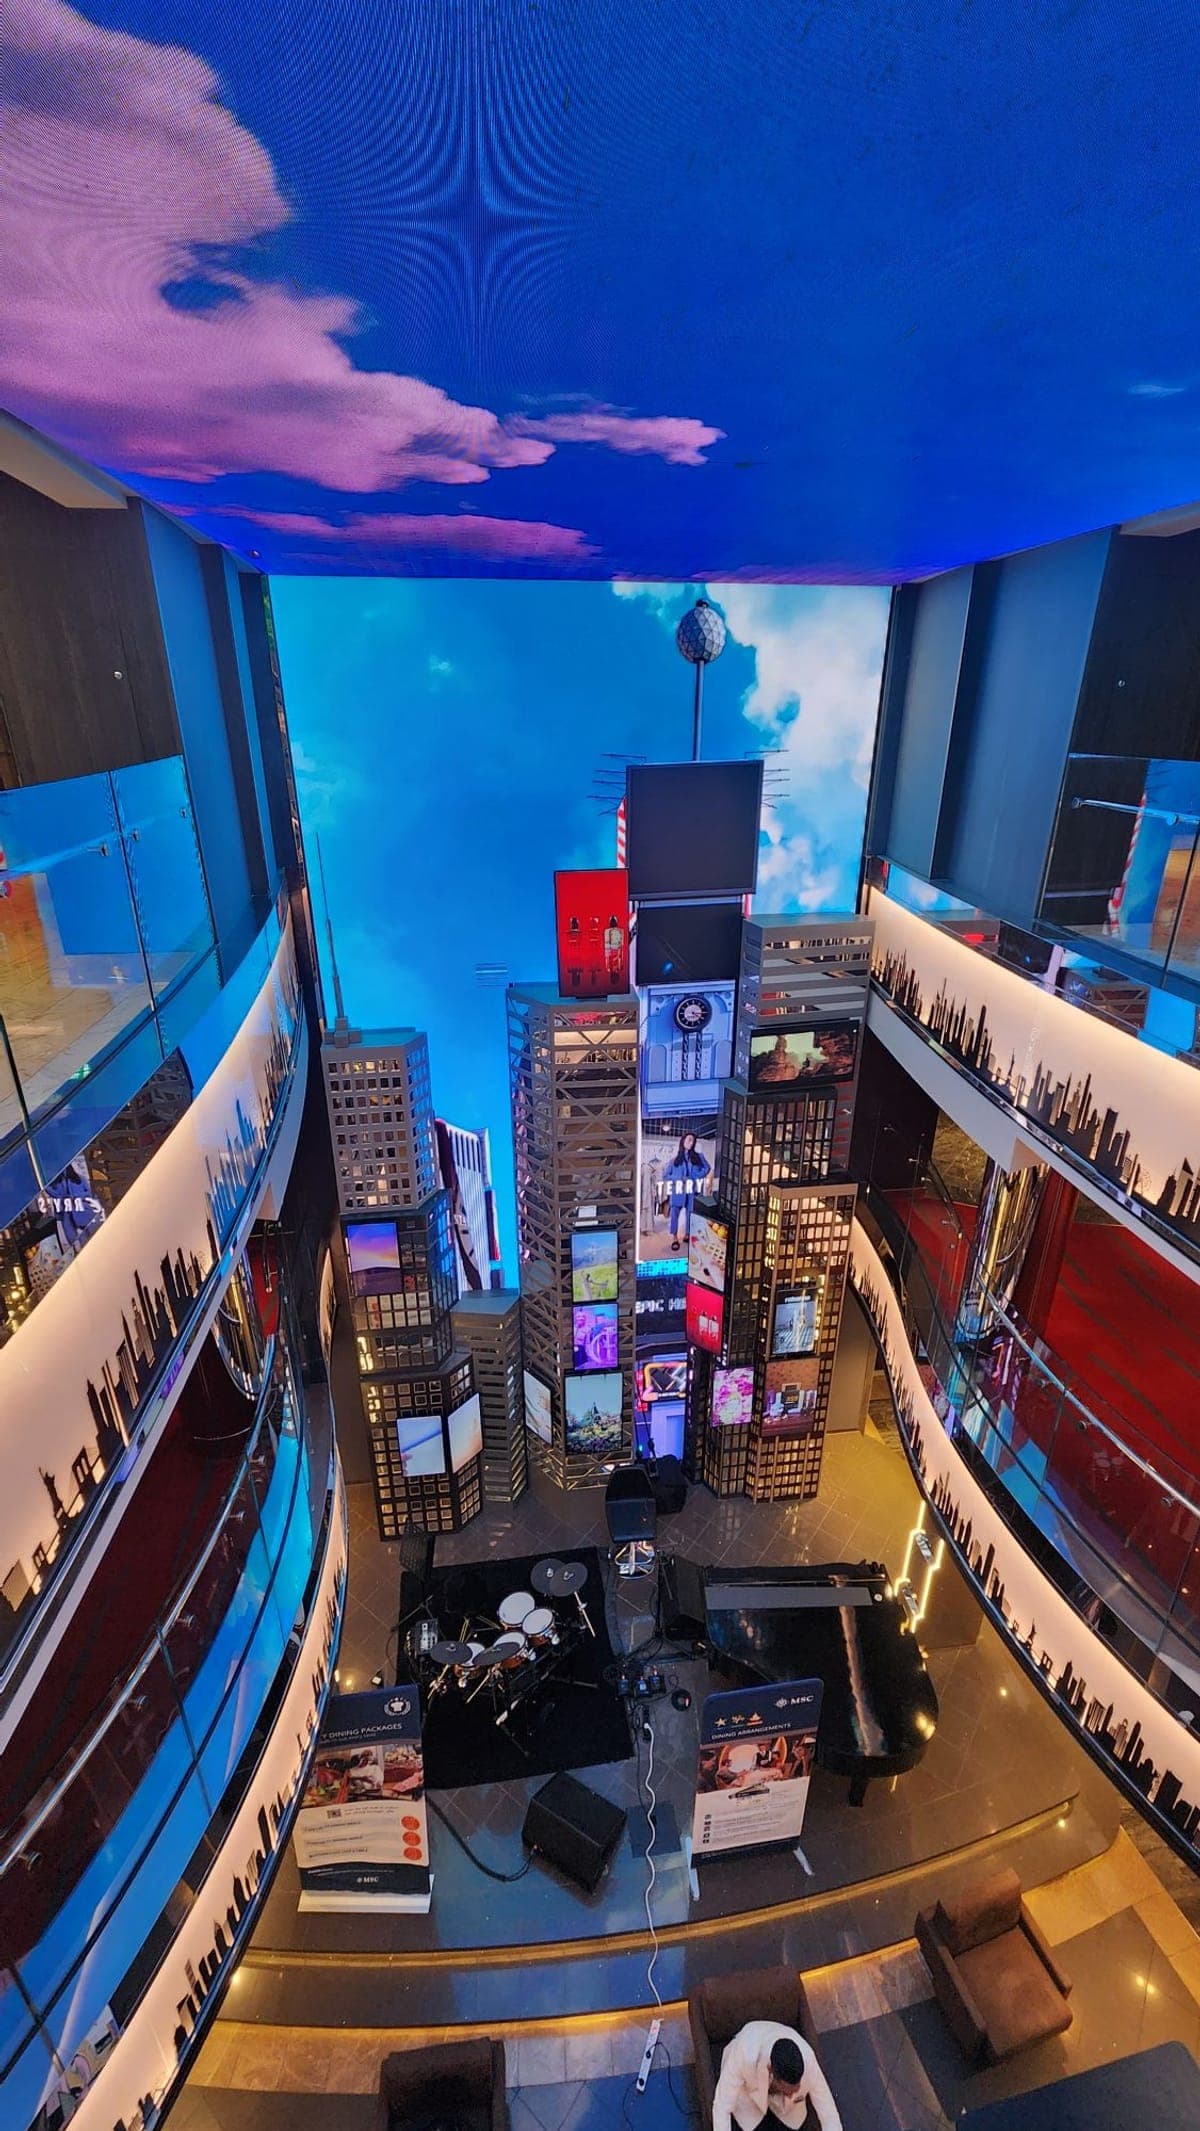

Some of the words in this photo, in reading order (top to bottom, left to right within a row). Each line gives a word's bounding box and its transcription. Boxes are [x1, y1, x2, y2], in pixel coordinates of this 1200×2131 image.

[790, 1695, 815, 1705] MSC
[328, 1728, 360, 1739] DINING
[361, 1723, 402, 1734] PACKAGES
[711, 1731, 737, 1740] DINING
[737, 1722, 791, 1736] ARRANGEMENTS
